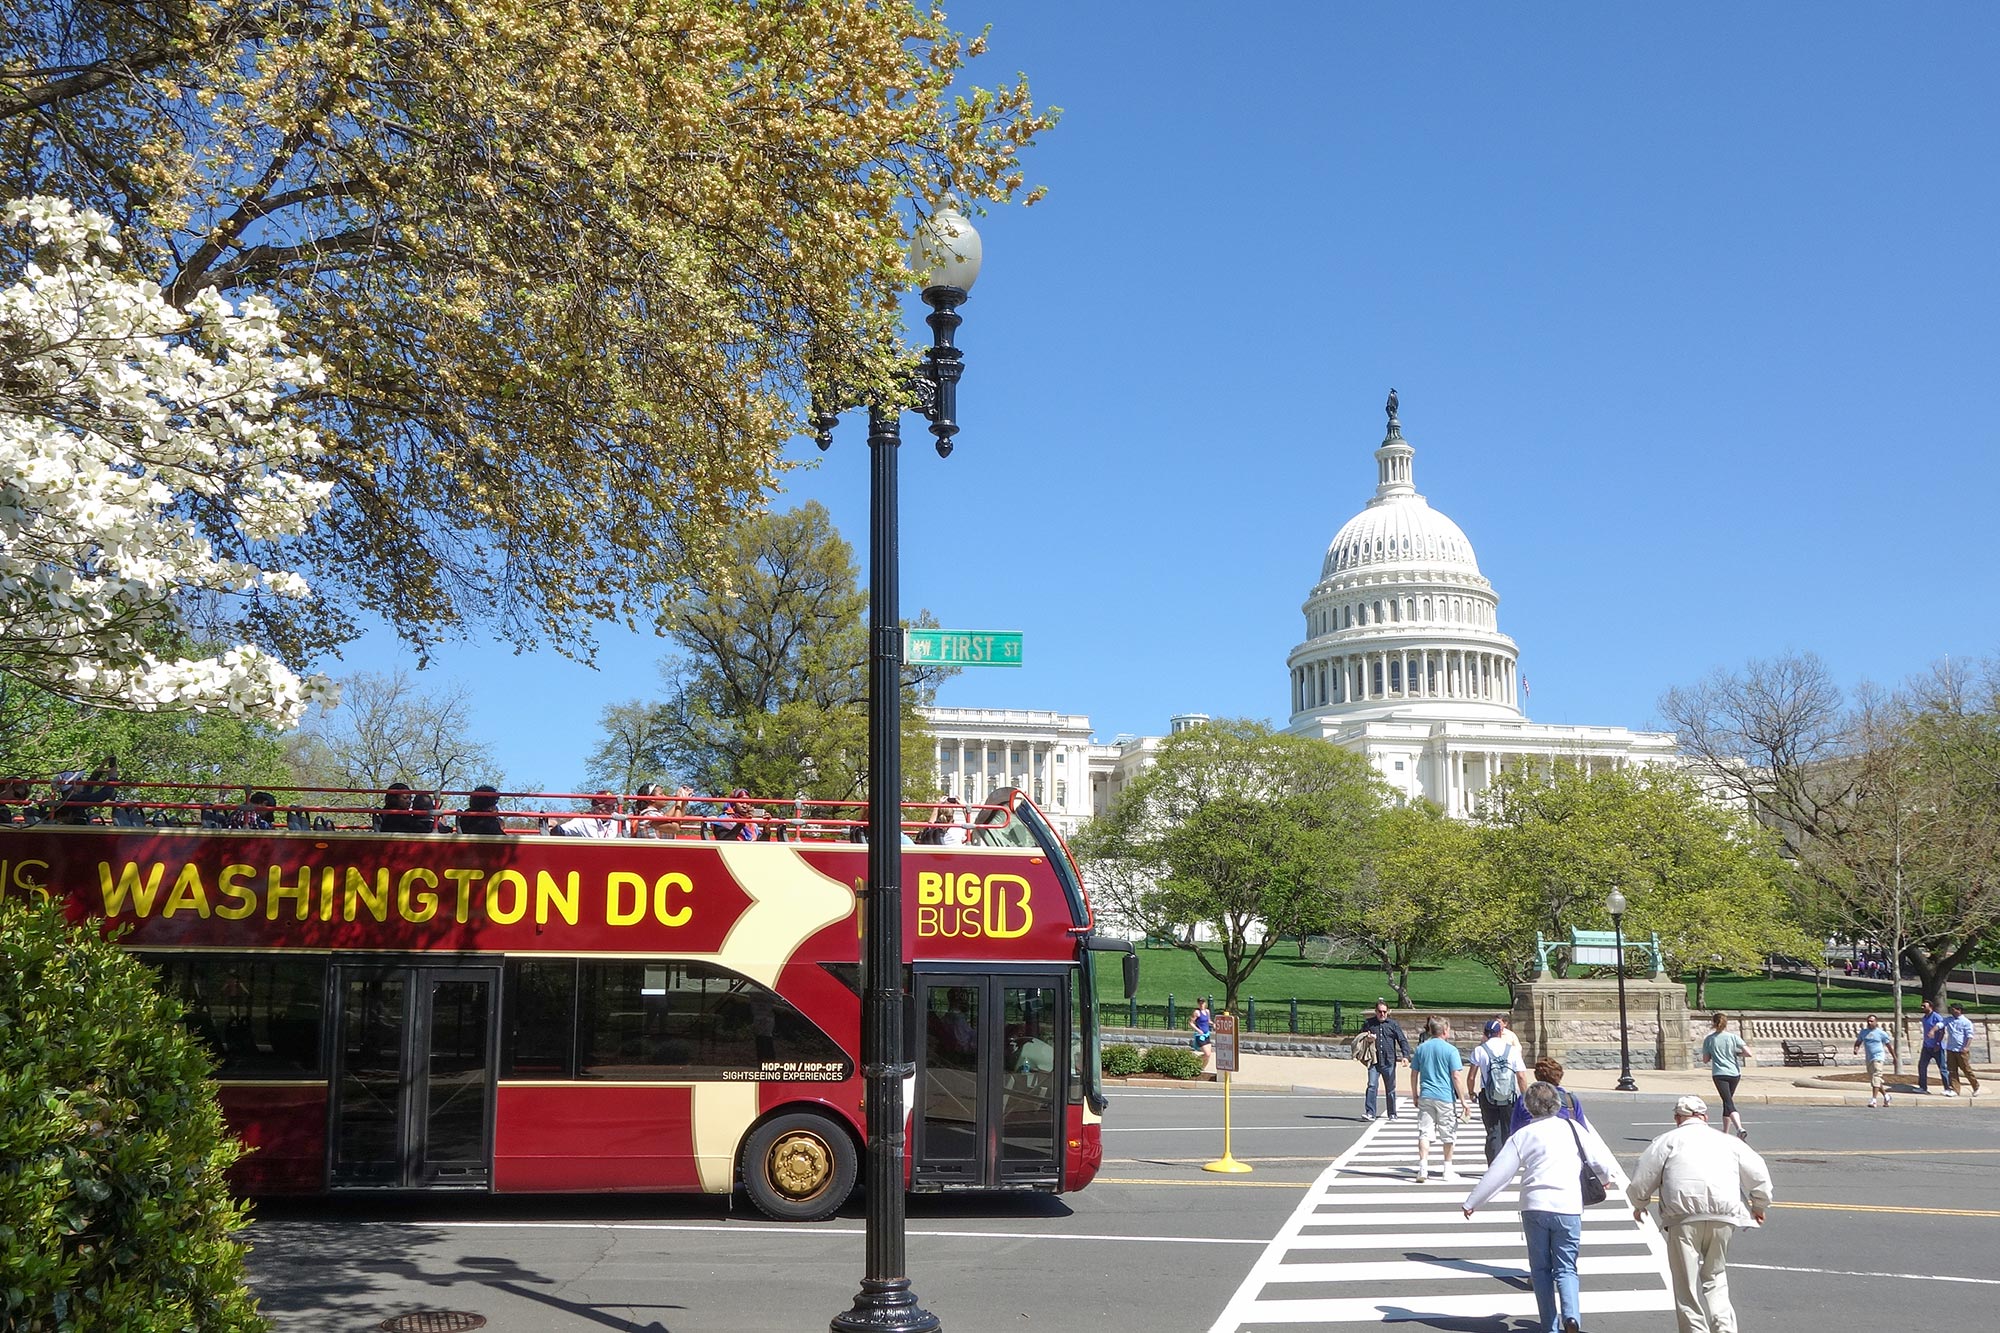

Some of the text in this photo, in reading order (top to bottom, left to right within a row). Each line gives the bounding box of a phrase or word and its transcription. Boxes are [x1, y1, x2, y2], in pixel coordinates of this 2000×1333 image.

[940, 636, 994, 661] FIRST
[1004, 642, 1019, 657] ST
[0, 859, 50, 908] S
[98, 861, 694, 927] WASHINGTON DC
[918, 872, 982, 906] BIG
[918, 907, 981, 938] BUS
[1216, 1019, 1233, 1030] STOP
[722, 1071, 843, 1080] SIGHTSEEING EXPERIENCES
[761, 1062, 796, 1072] HOP-ON
[805, 1063, 844, 1072] HOP-OFF
